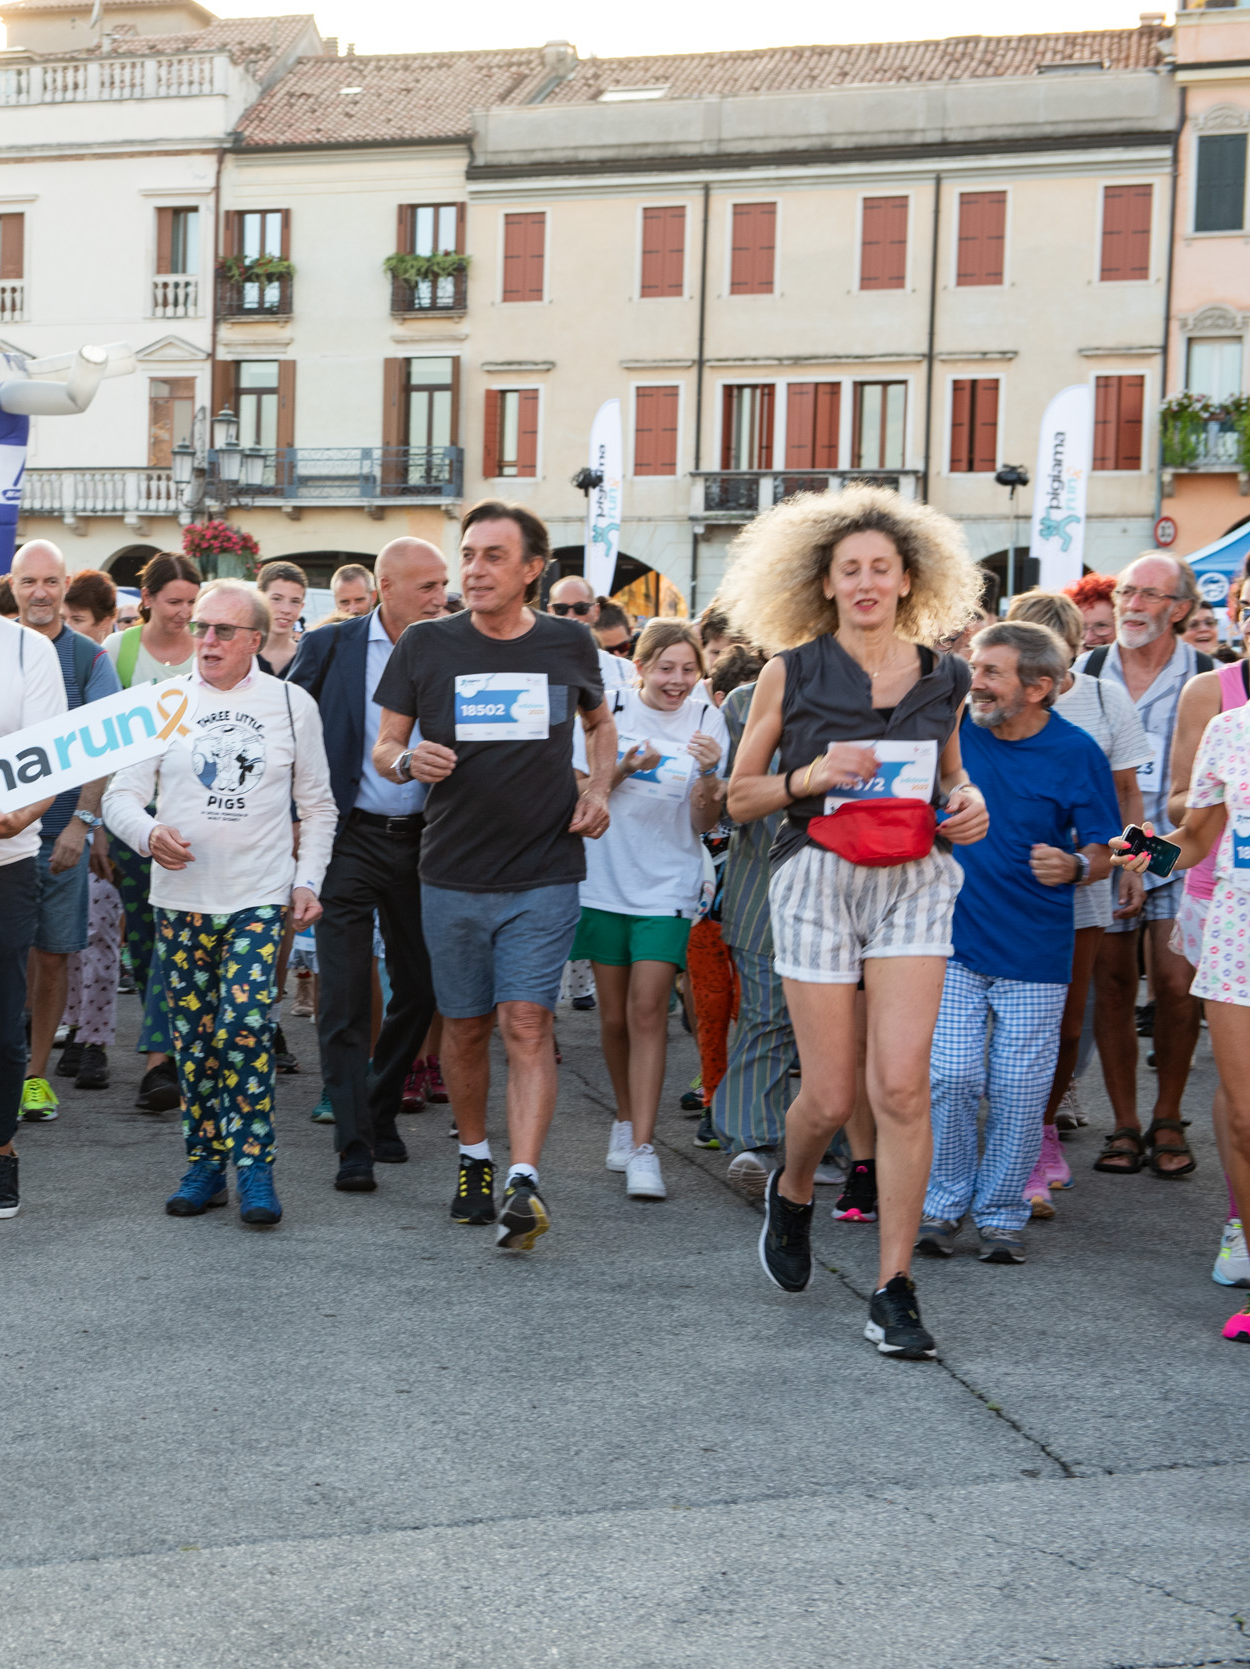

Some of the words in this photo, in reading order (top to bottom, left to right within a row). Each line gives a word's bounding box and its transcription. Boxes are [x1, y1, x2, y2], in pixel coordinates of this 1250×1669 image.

[1046, 431, 1066, 510] pigiama
[608, 488, 619, 520] run
[1065, 478, 1078, 511] run
[197, 710, 230, 728] THREE
[235, 711, 265, 732] LITTLE
[460, 704, 506, 717] 18502
[207, 795, 246, 810] PIGS
